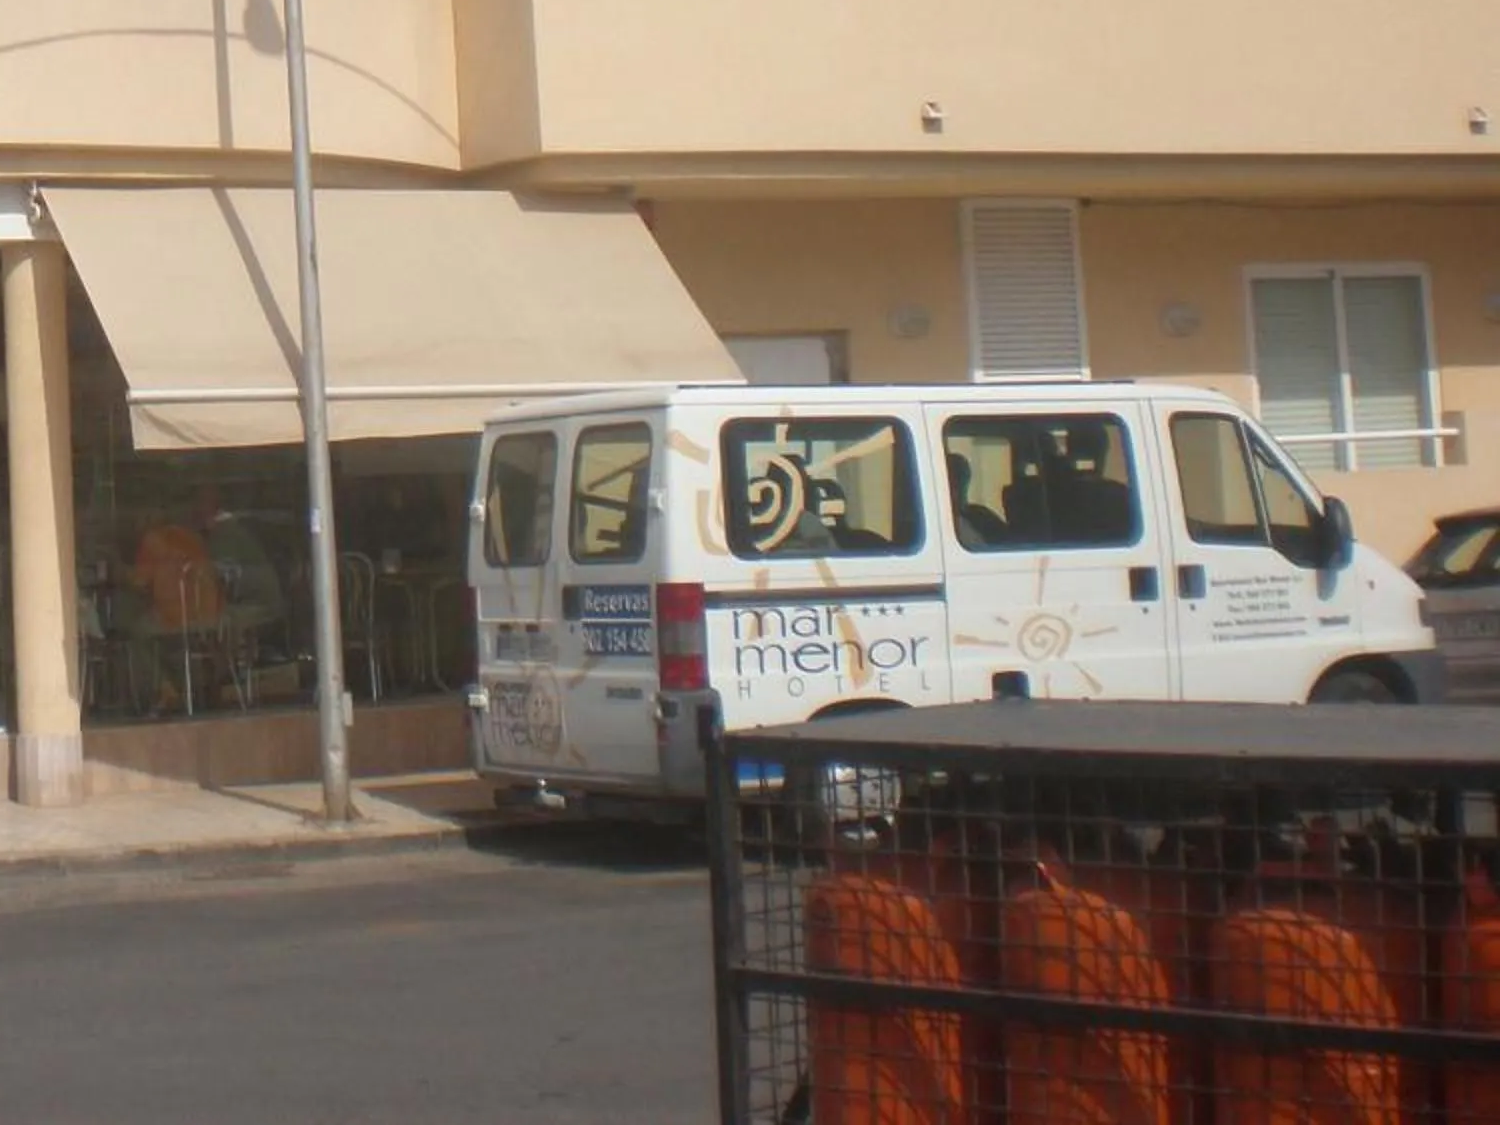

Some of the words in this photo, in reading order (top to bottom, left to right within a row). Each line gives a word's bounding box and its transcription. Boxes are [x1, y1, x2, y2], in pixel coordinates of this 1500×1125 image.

[584, 588, 649, 613] Reservas
[732, 605, 843, 640] mar
[735, 636, 929, 676] menor
[737, 673, 931, 700] HOTEL
